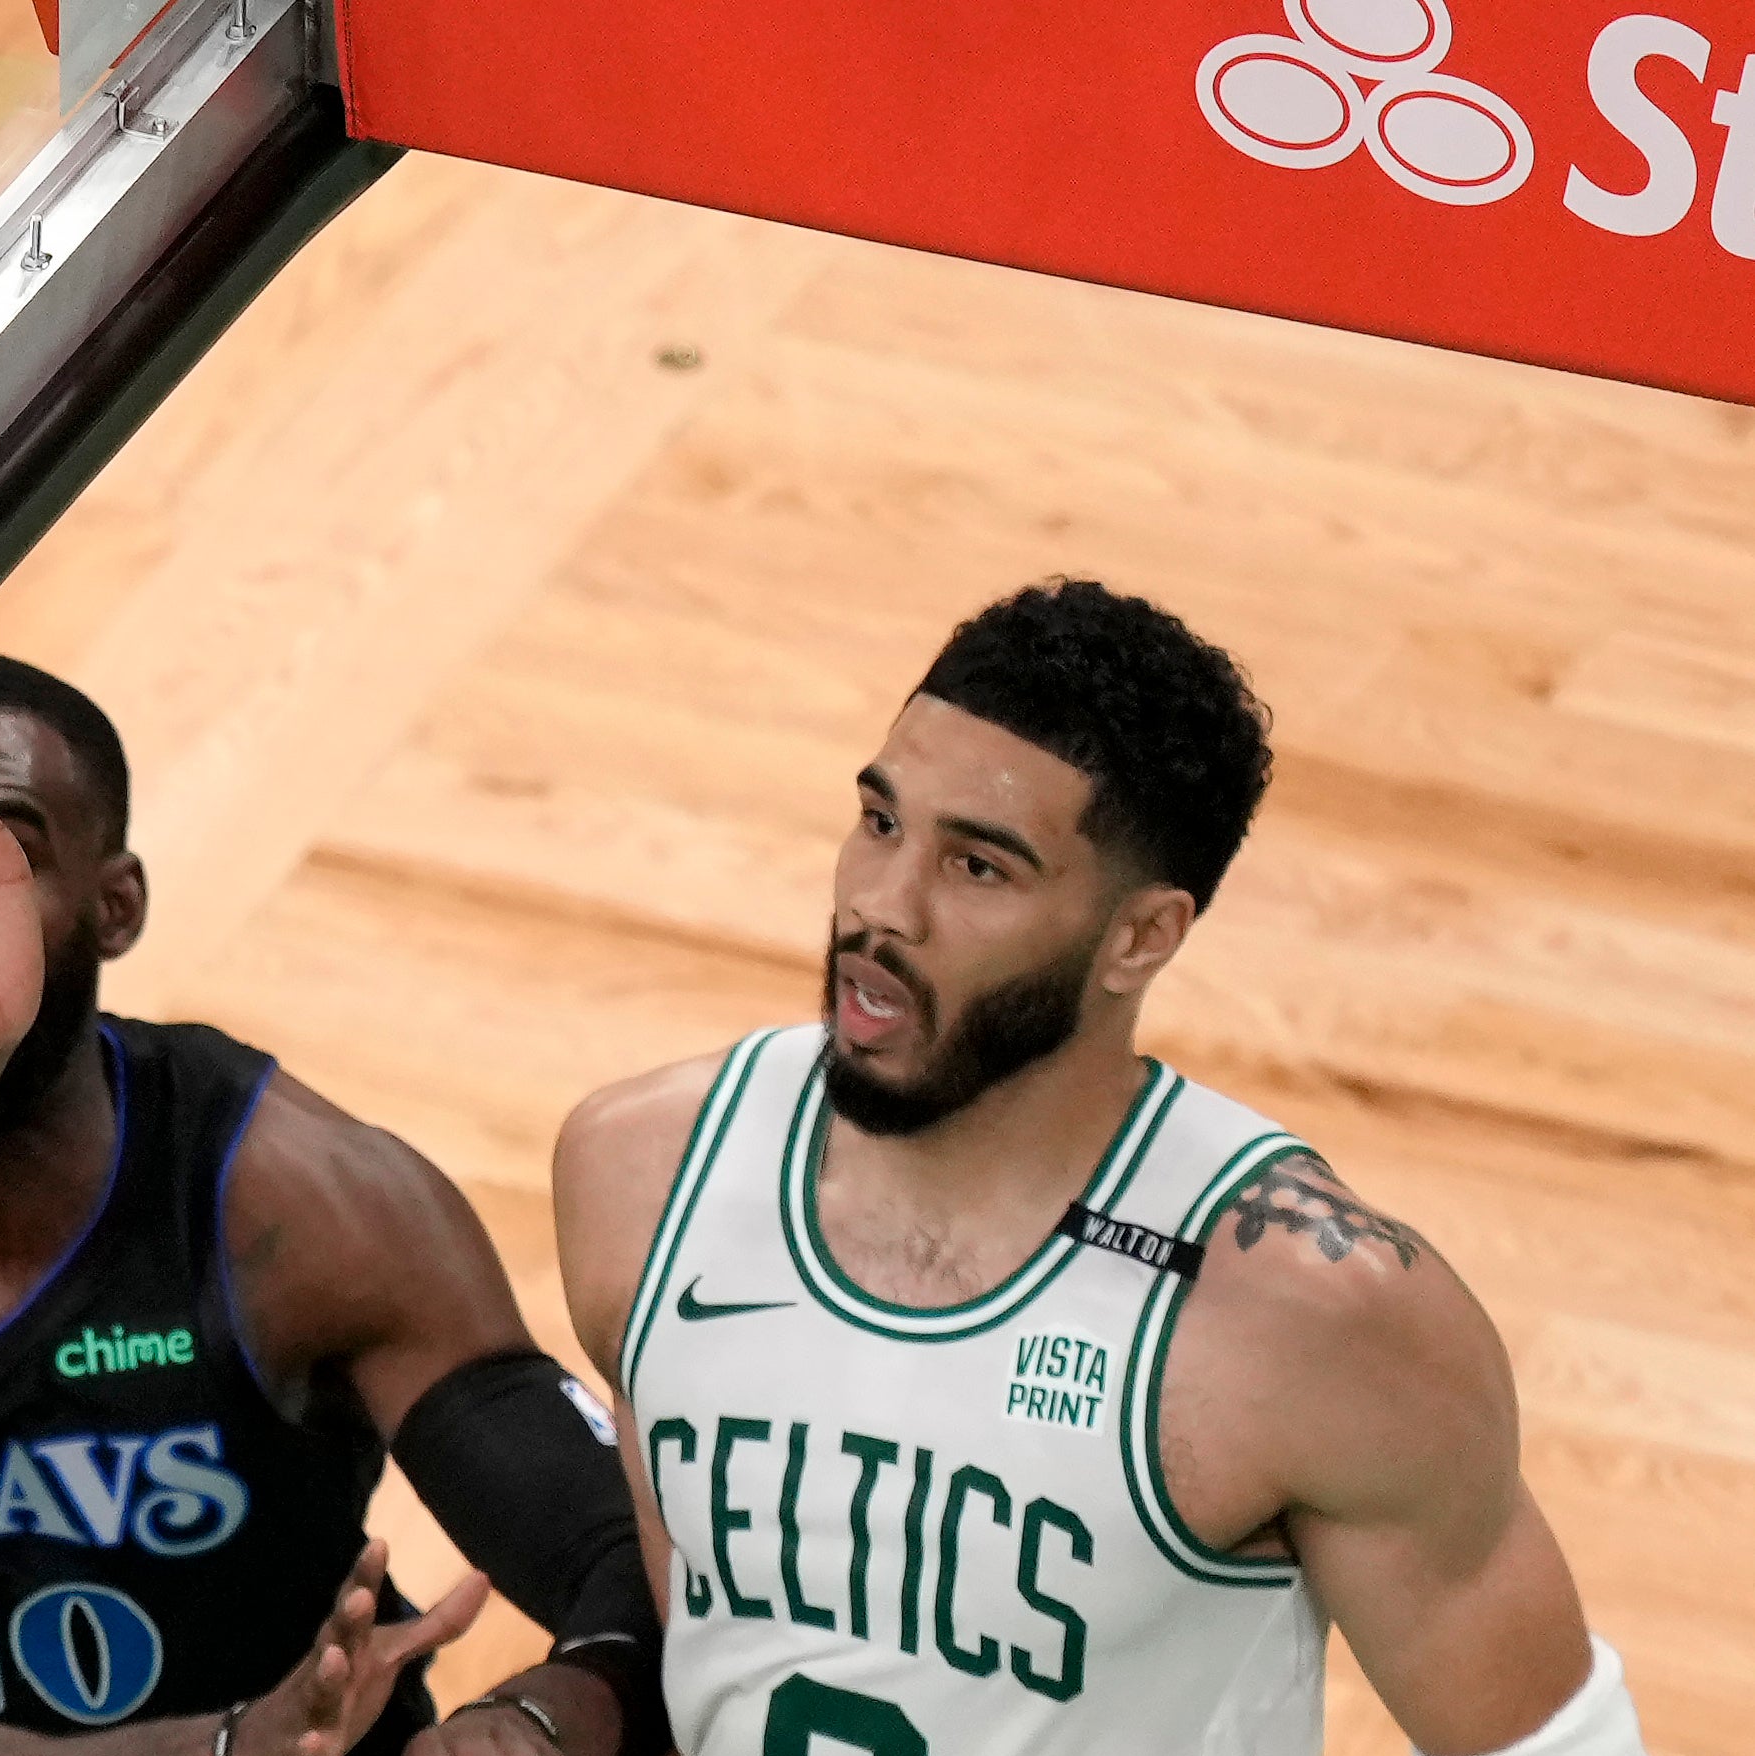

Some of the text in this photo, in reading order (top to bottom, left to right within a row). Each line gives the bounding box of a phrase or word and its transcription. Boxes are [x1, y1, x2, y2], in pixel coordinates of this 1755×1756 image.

[1082, 1213, 1176, 1267] WALTON
[55, 1323, 194, 1379] chime
[1016, 1335, 1108, 1394] VISTA
[1007, 1382, 1104, 1428] PRINT
[647, 1414, 1094, 1703] CELTICS
